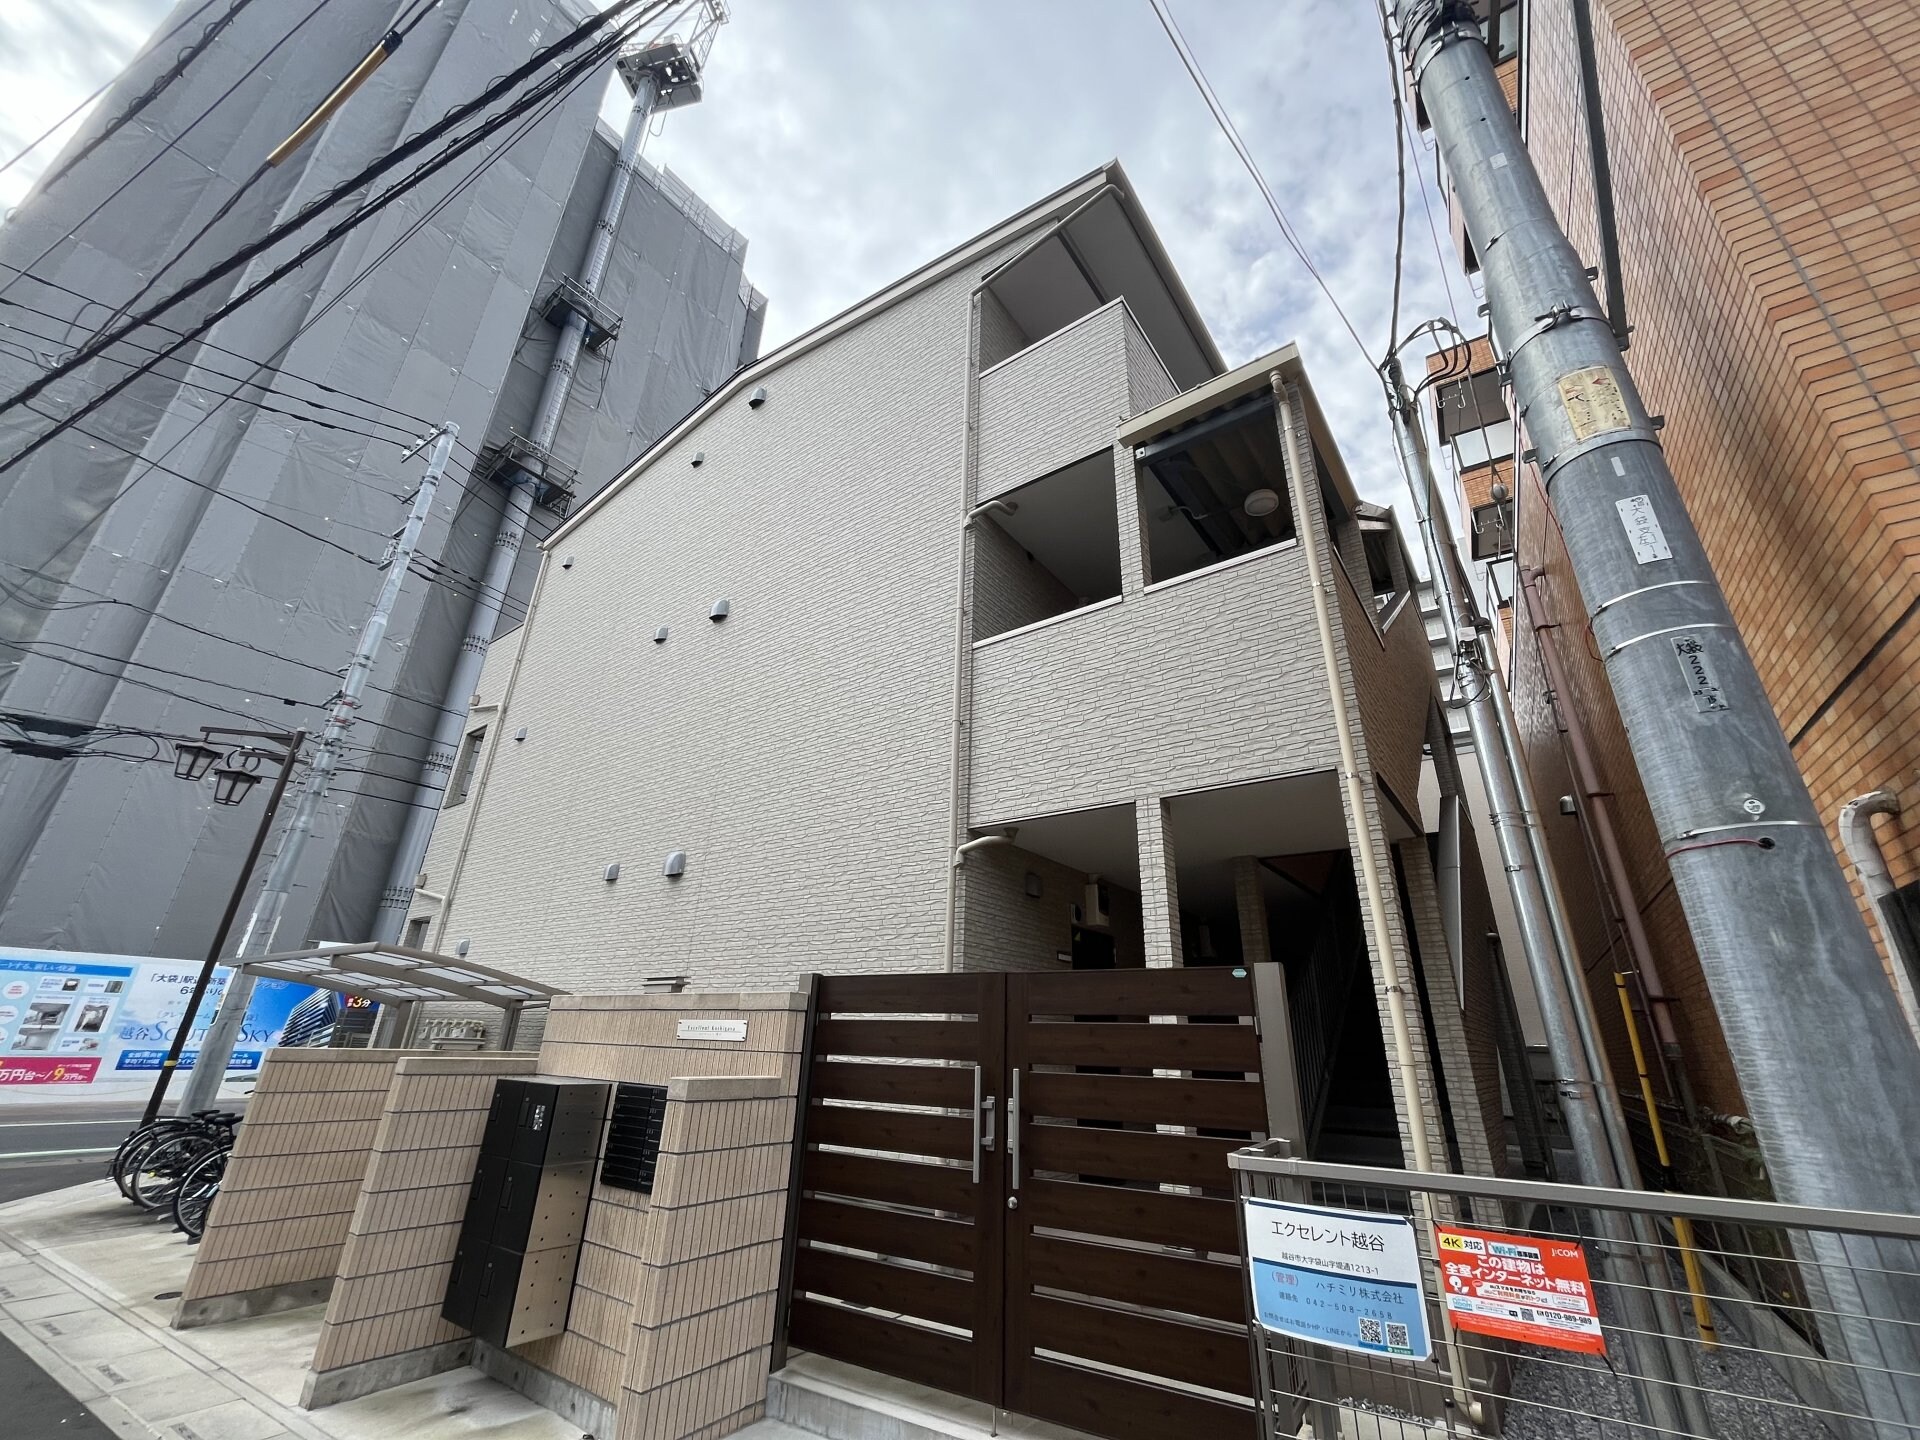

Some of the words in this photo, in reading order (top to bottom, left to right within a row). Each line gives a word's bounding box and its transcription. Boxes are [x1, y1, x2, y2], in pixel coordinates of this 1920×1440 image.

[236, 1023, 275, 1043] SKY
[1271, 1220, 1385, 1253] エクセレント越谷
[1443, 1237, 1461, 1248] 4K
[1463, 1240, 1483, 1251] 対応
[1477, 1254, 1546, 1276] この建物は
[1444, 1261, 1587, 1296] 全室インターネット無料
[1278, 1291, 1299, 1303] 連絡先
[1315, 1281, 1405, 1305] ハチミリ株式会社
